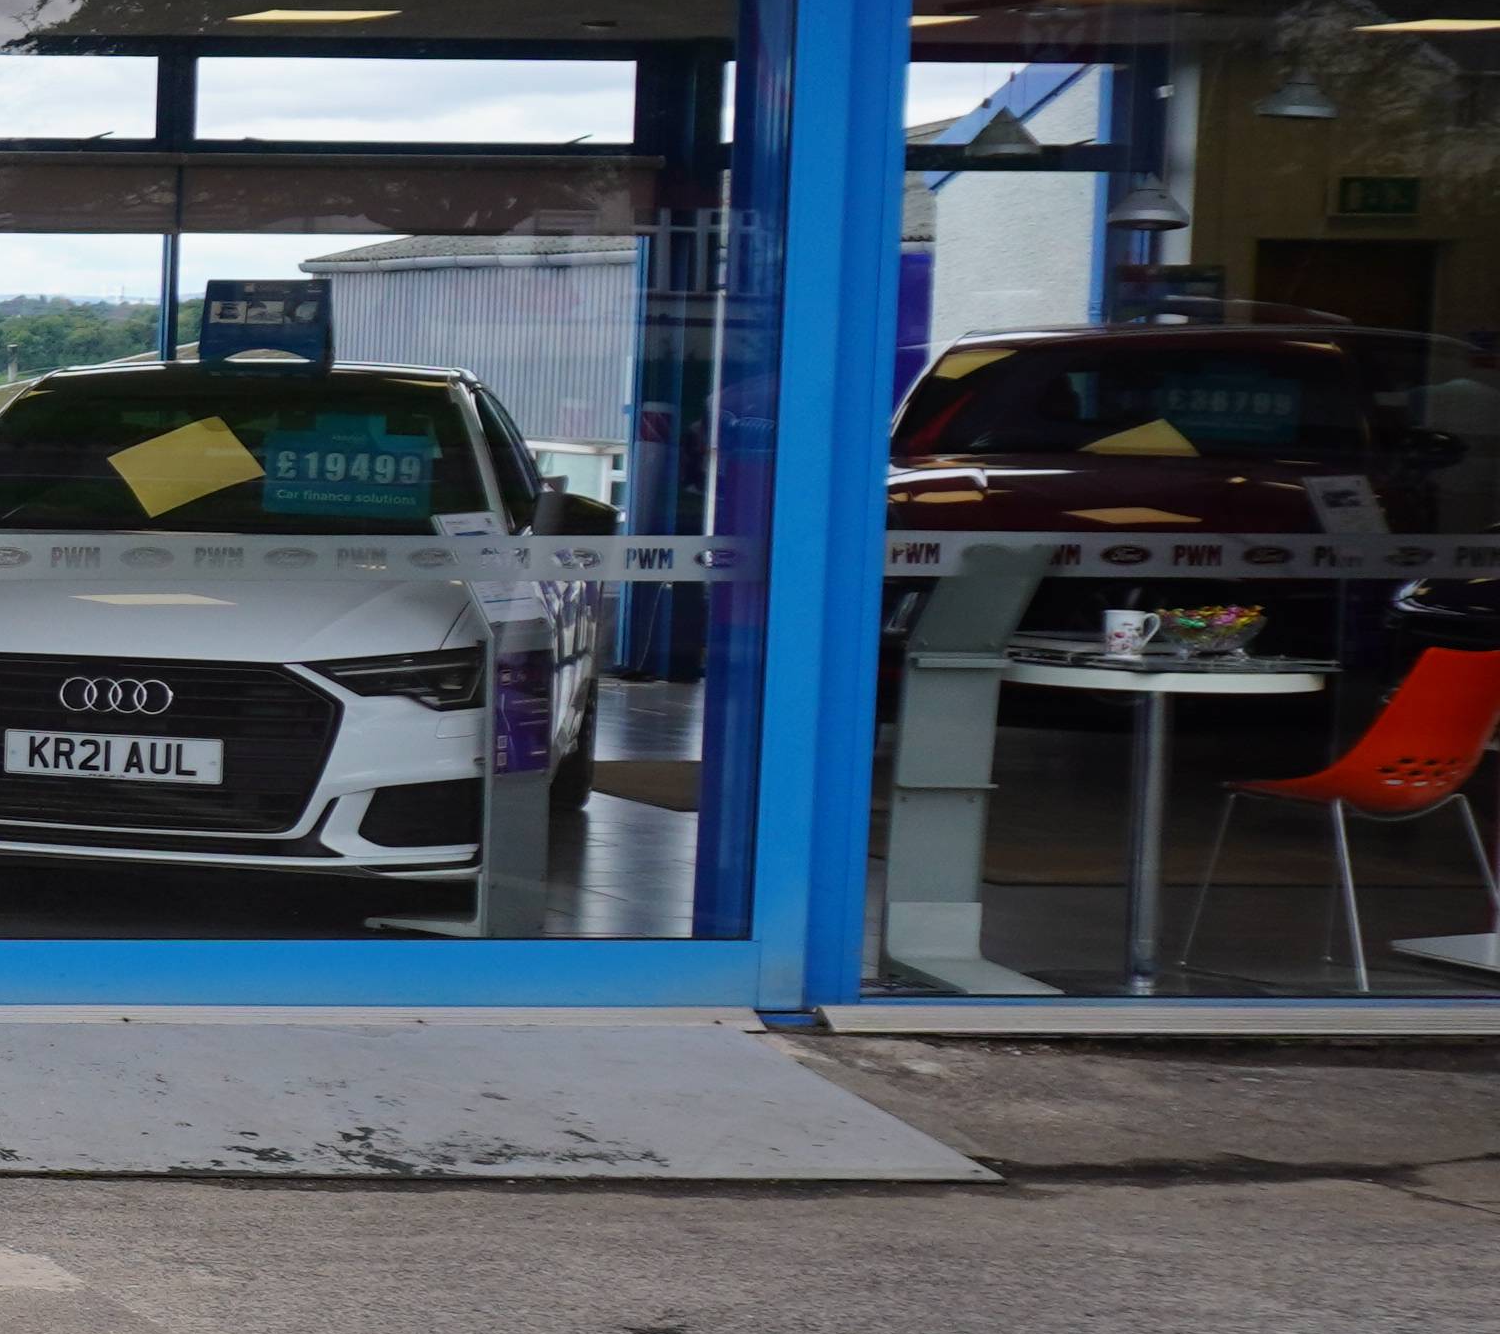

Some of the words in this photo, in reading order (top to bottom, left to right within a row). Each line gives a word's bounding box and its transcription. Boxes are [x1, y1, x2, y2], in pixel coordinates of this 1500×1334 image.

[275, 450, 422, 485] £19499
[275, 488, 299, 500] Car
[303, 489, 351, 503] finance
[355, 492, 417, 507] solutions
[50, 547, 101, 568] PWM
[626, 548, 674, 570] PWM
[1173, 544, 1223, 566] PWM
[28, 735, 111, 772] KR21
[124, 741, 198, 777] AUL
